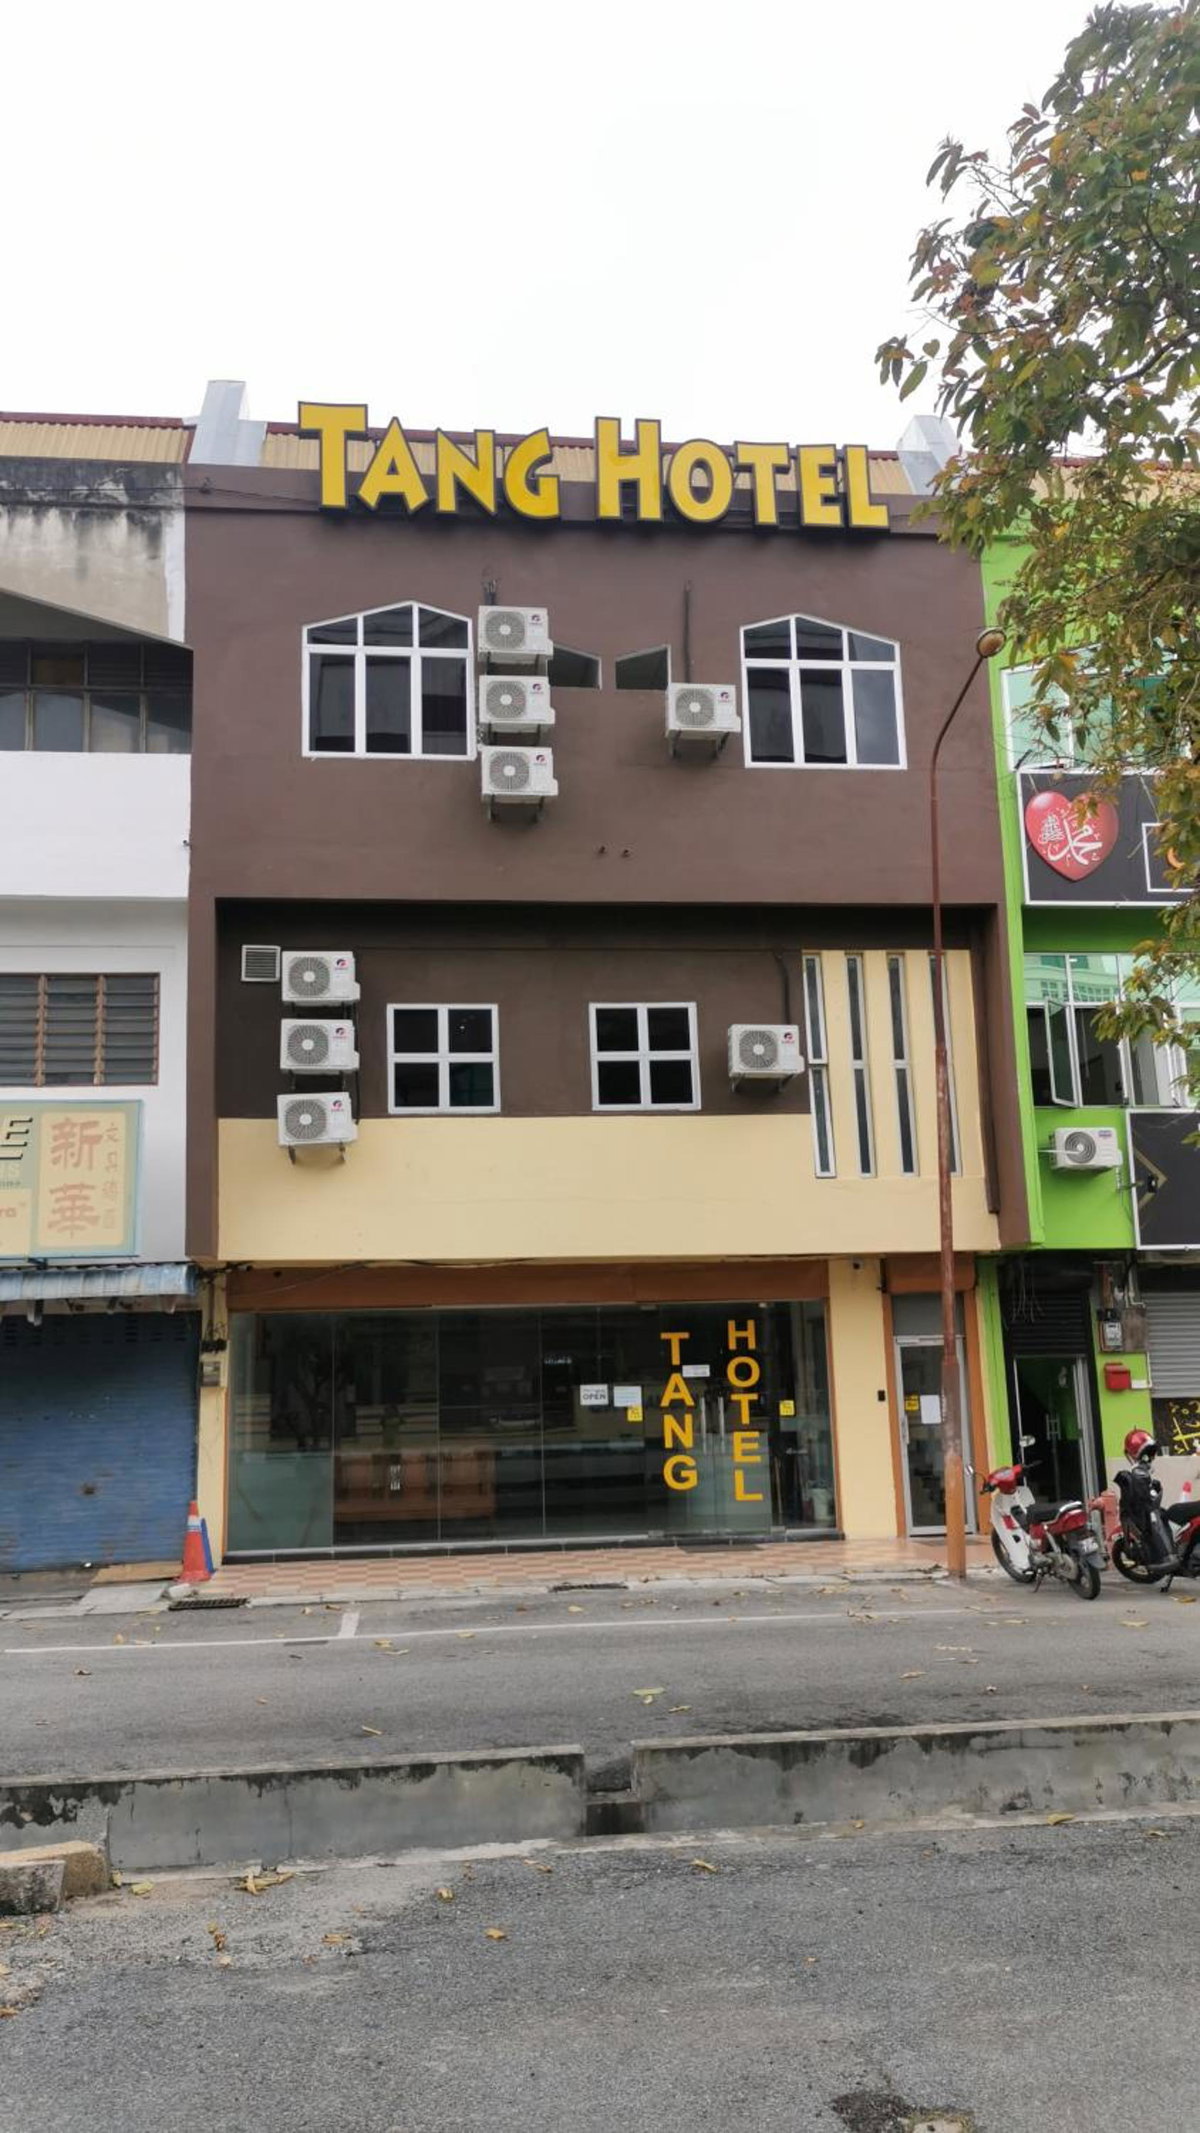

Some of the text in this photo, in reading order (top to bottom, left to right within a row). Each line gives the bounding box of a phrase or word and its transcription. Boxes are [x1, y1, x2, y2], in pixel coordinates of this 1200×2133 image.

[298, 401, 891, 530] TANG HOTEL
[48, 1117, 103, 1240] 新華
[582, 1393, 607, 1401] OPEN
[660, 1331, 698, 1491] TANG
[726, 1319, 764, 1502] HOTEL
